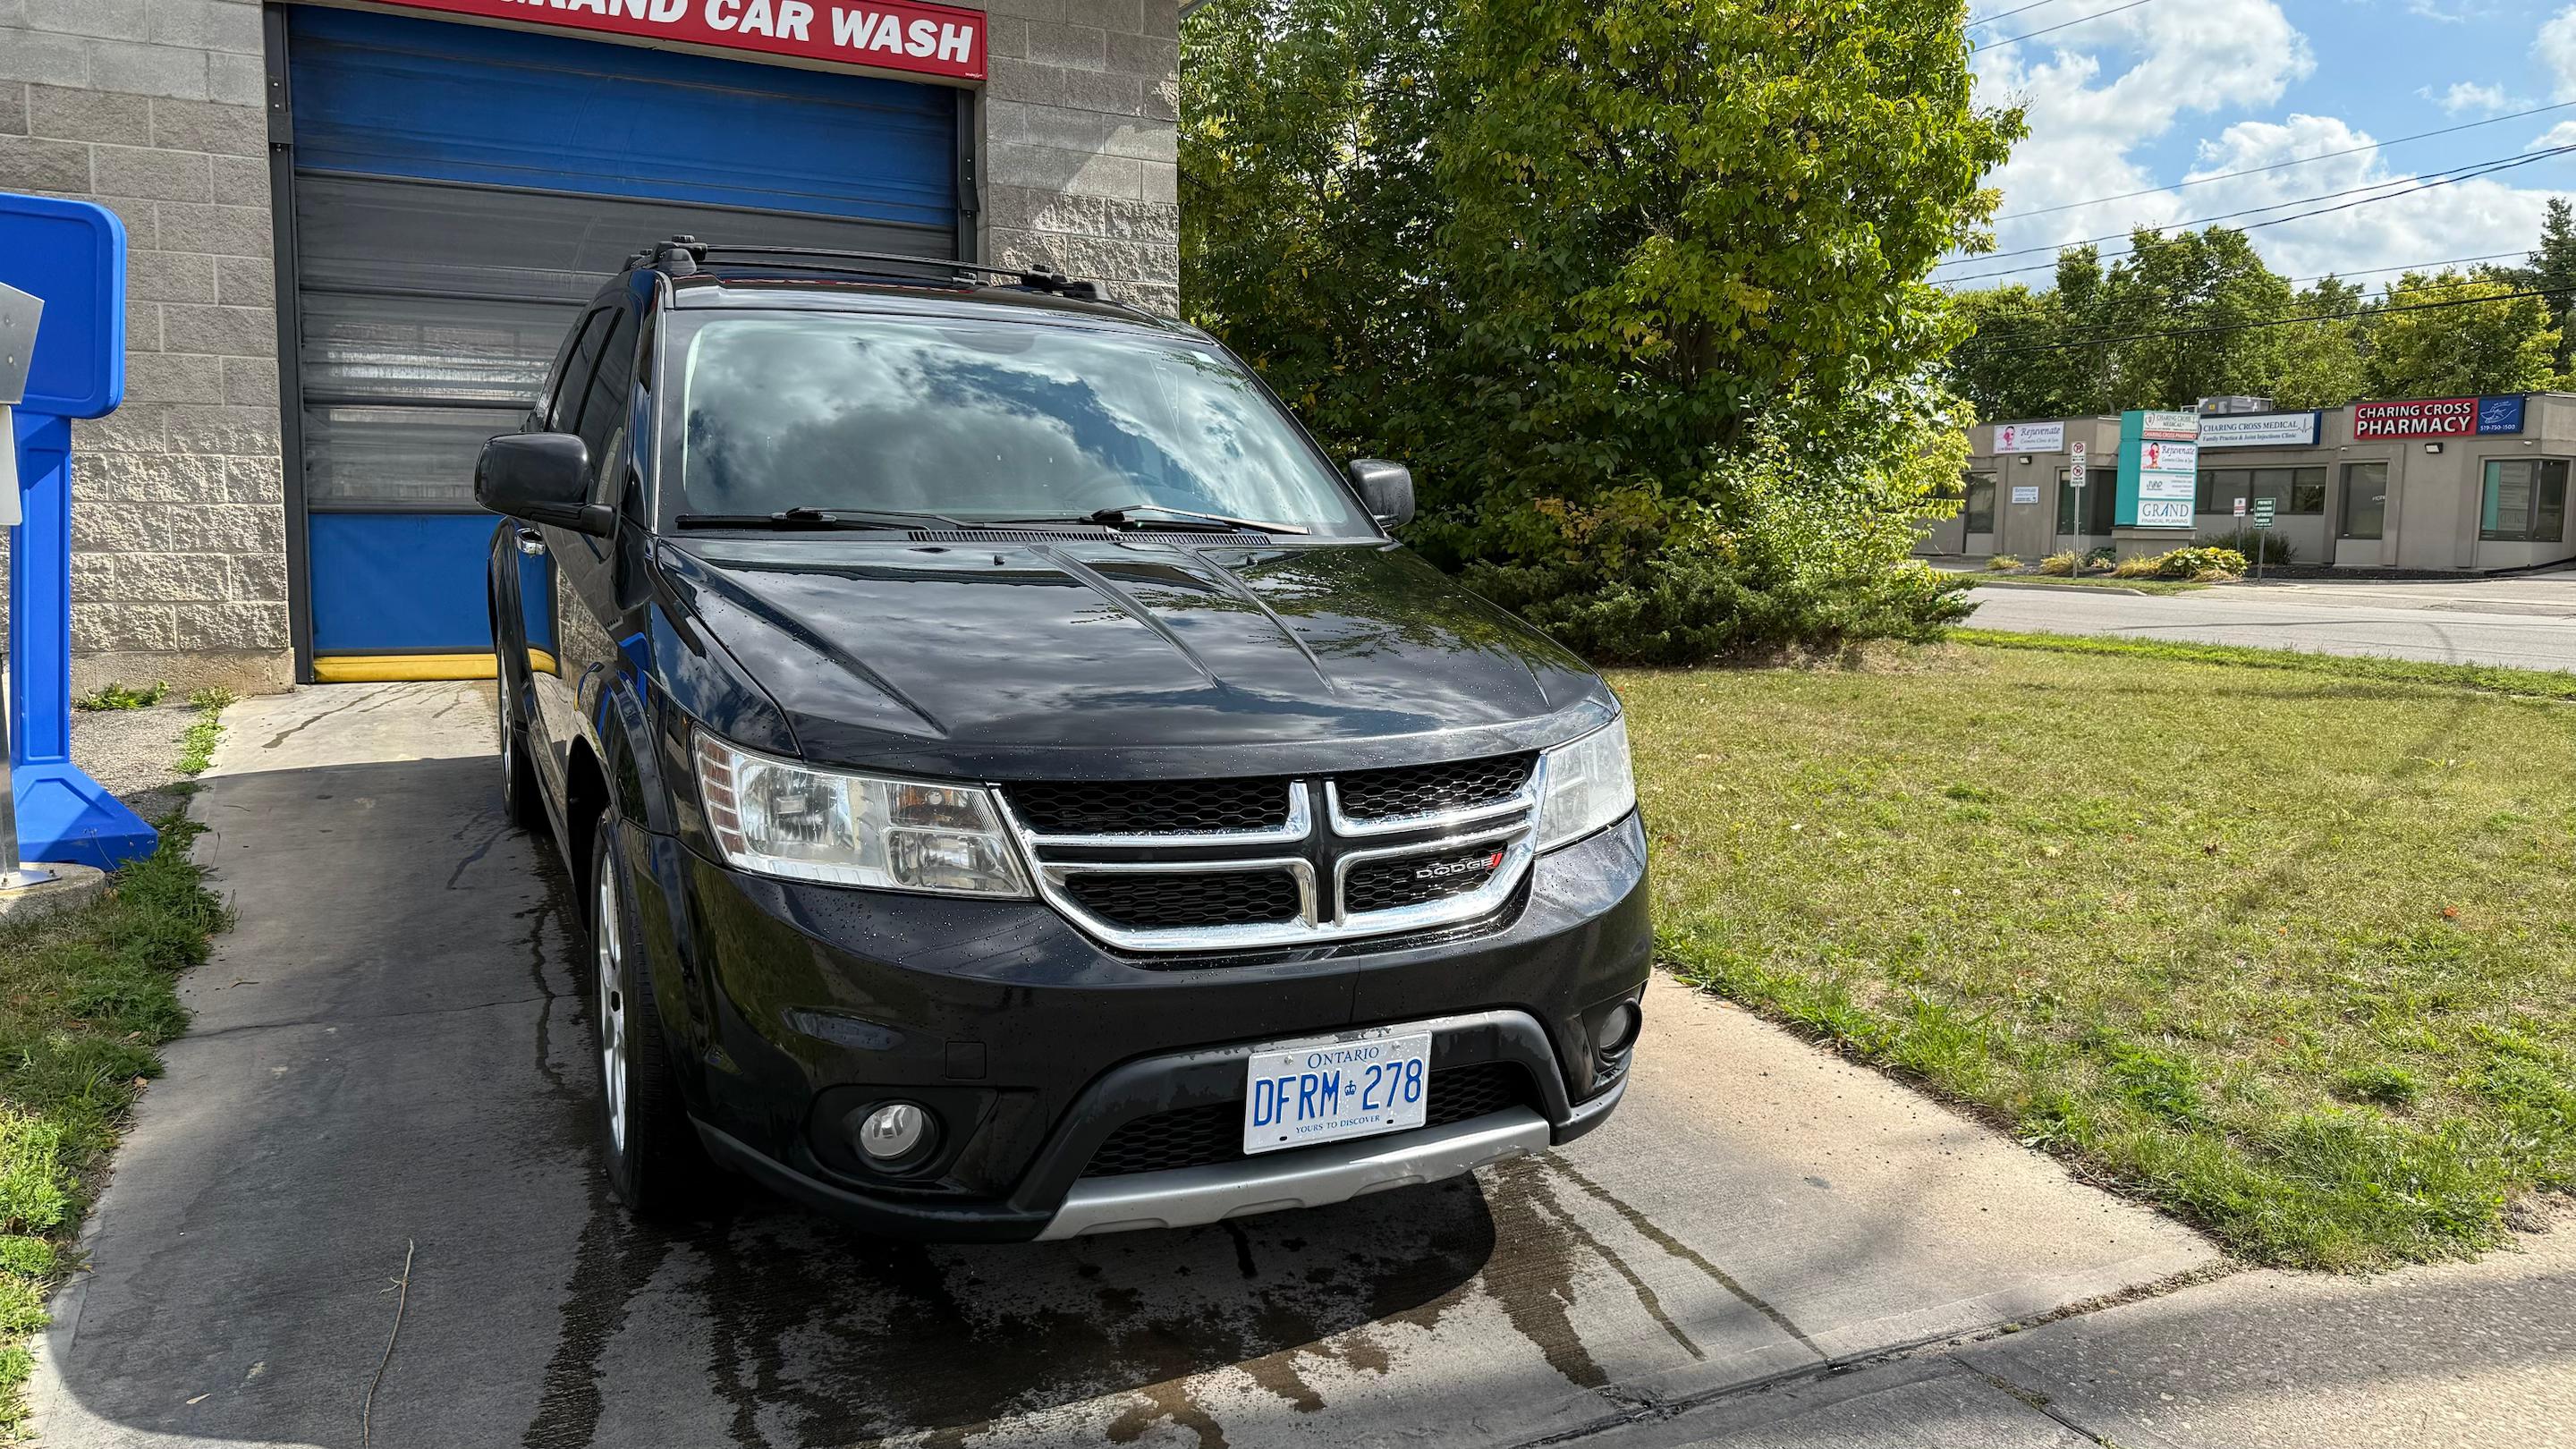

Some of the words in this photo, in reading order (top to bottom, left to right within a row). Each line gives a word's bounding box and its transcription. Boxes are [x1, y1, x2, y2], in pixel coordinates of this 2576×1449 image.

[705, 0, 814, 42] CAR
[831, 6, 974, 64] WASH
[2358, 404, 2420, 419] CHARING
[2424, 402, 2471, 416] CROSS
[2021, 426, 2061, 439] Rejuvenate
[2203, 423, 2237, 433] CHARING
[2238, 421, 2262, 431] CROSS
[2263, 419, 2299, 430] MEDICAL
[2282, 431, 2297, 439] Clinic
[2356, 416, 2471, 436] PHARMACY
[2161, 445, 2195, 457] Rejuvenate
[2142, 503, 2190, 518] GRAND
[1416, 857, 1494, 879] DODGE
[1308, 1046, 1379, 1069] ONTARIO
[1253, 1070, 1342, 1128] DFRM
[1362, 1058, 1424, 1111] 278
[1296, 1123, 1323, 1134] YOURS
[1341, 1114, 1381, 1127] DISCOVER
